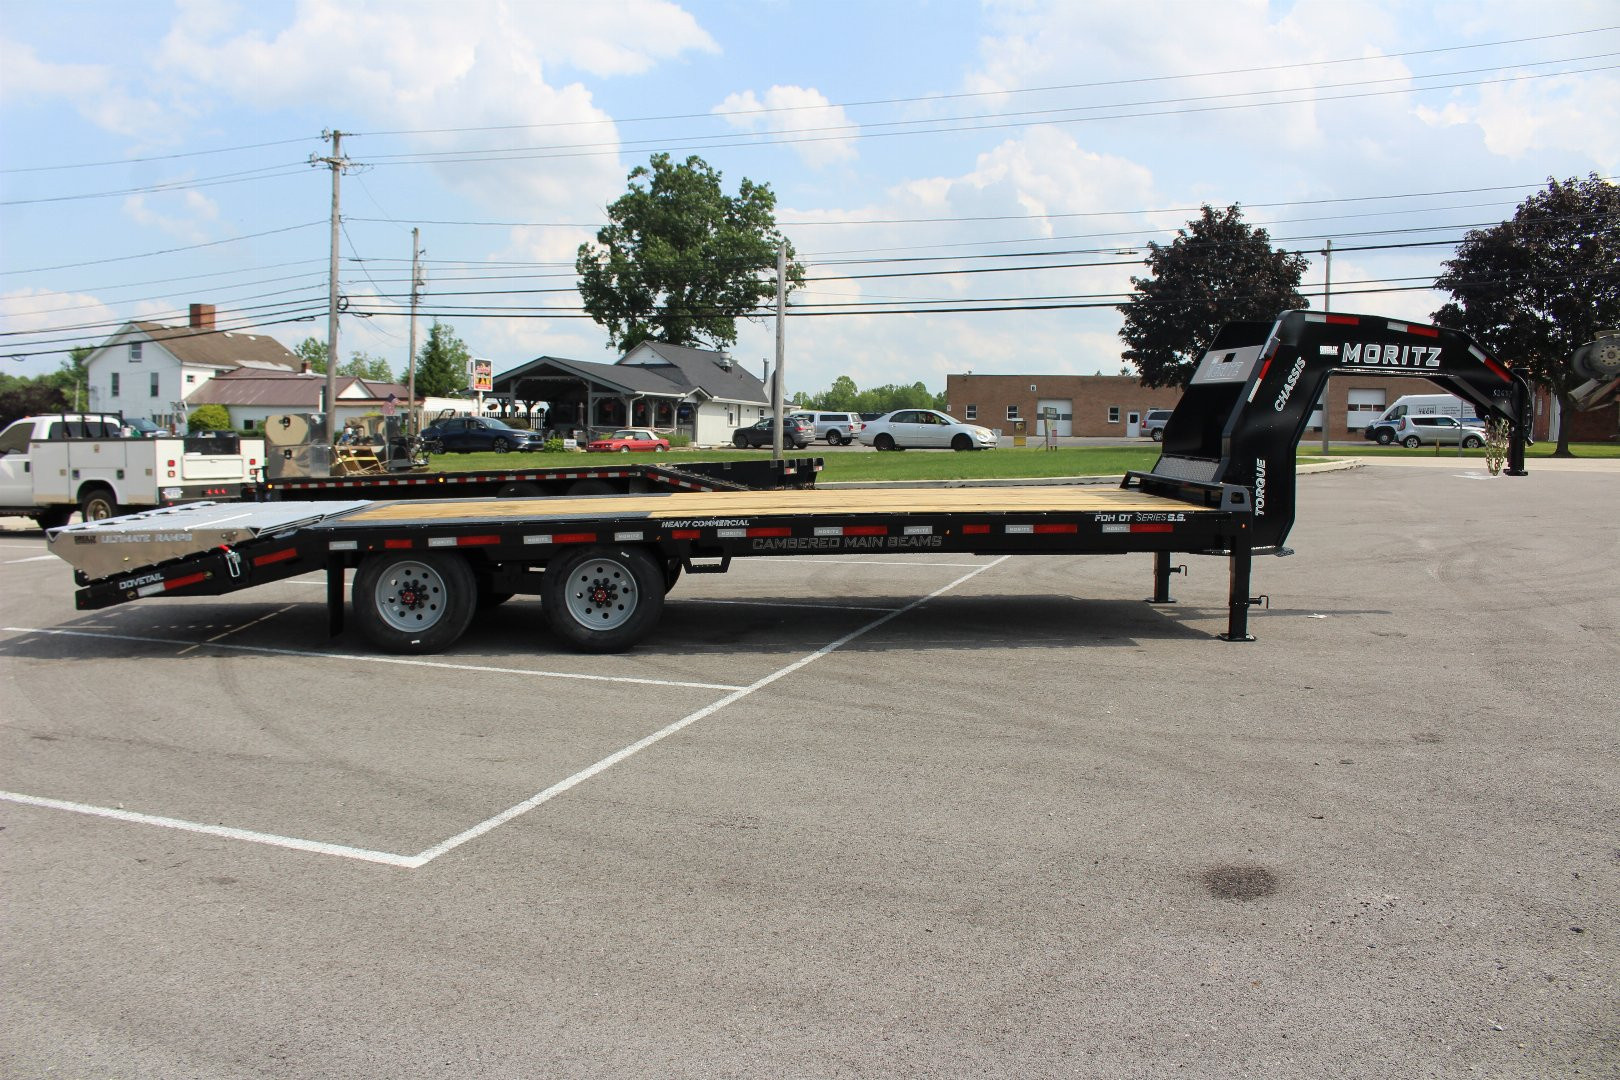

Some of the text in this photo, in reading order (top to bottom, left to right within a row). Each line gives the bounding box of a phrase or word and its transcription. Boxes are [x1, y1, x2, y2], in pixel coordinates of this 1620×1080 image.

[1341, 342, 1442, 367] MORITZ
[1274, 356, 1306, 412] CHASSIS
[1255, 458, 1266, 517] TORQUE
[661, 519, 750, 528] HEAVY COMMERCIAL
[1136, 513, 1167, 522] SERIES
[101, 533, 151, 544] ULTIMATE
[155, 533, 193, 543] RAMPS
[752, 535, 942, 550] CAMBERED MAIN BEAMS
[118, 573, 165, 590] DOVETAIL
